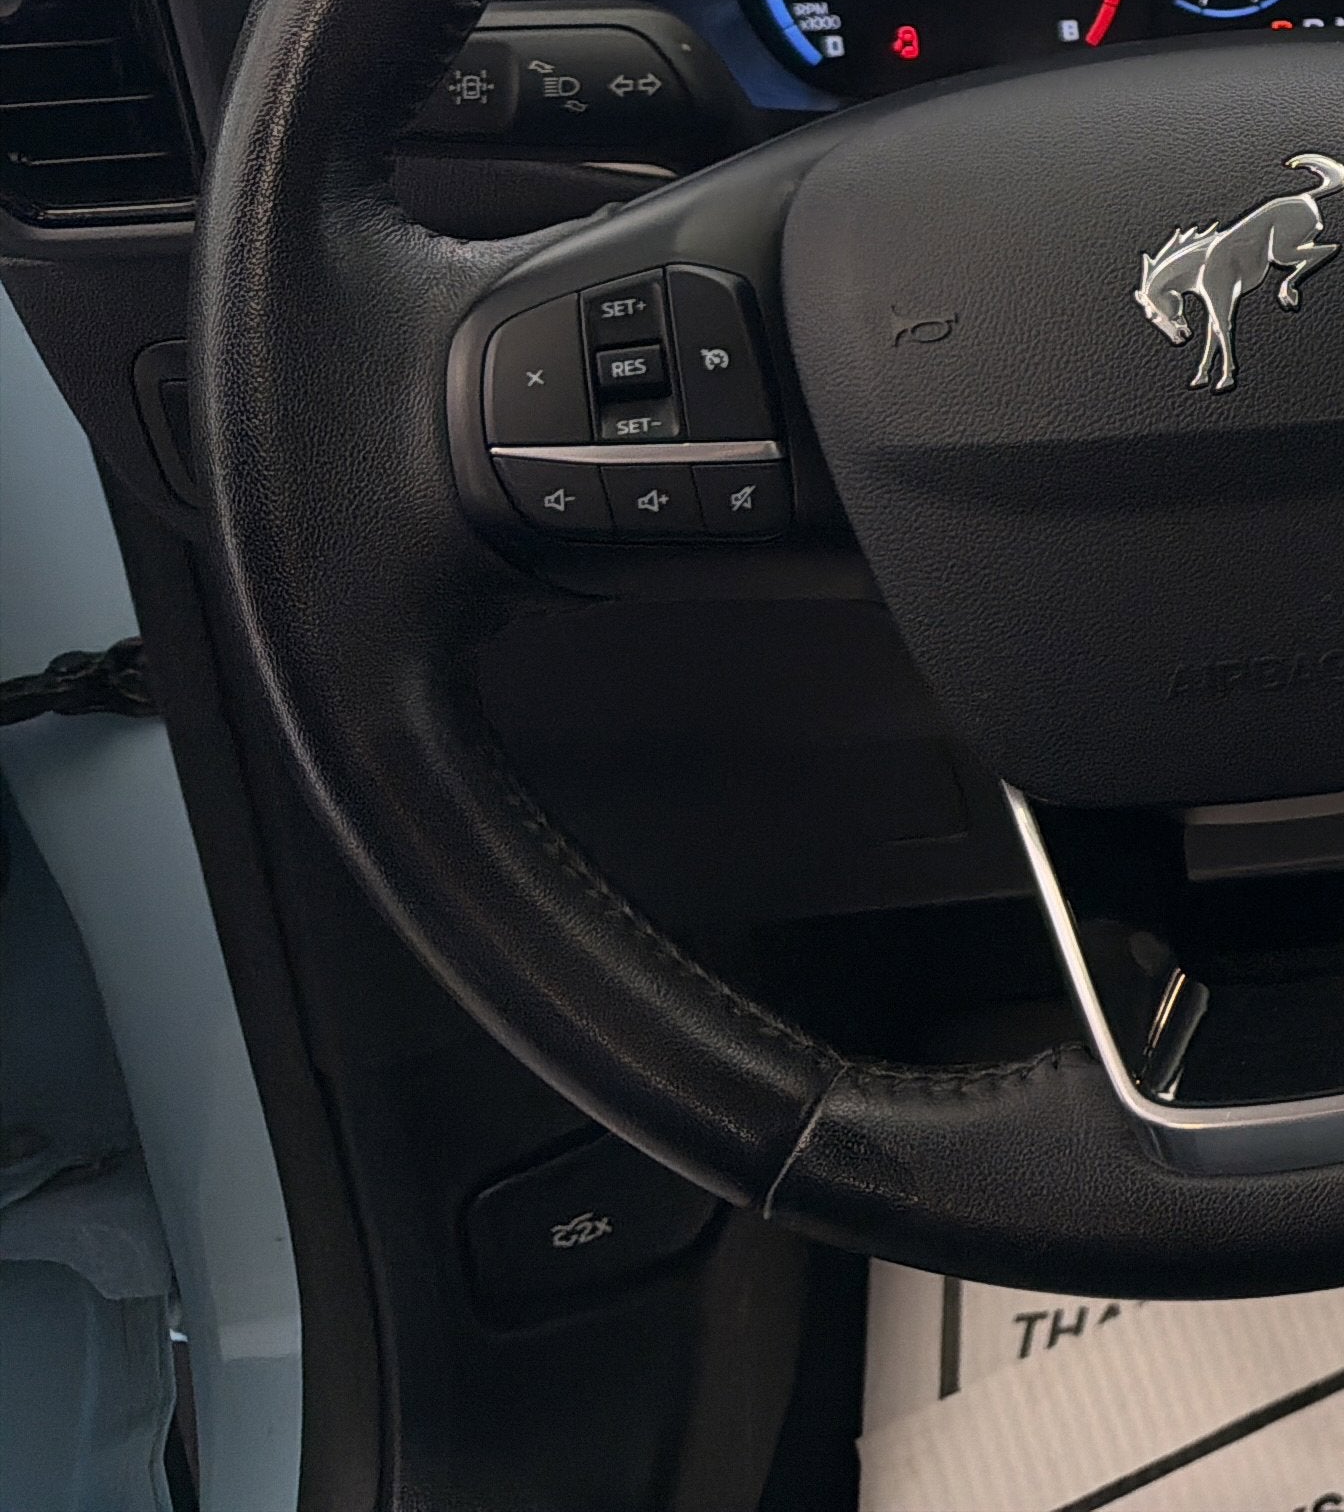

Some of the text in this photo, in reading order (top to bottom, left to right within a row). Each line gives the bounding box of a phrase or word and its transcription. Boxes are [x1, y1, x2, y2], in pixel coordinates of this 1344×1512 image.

[1058, 19, 1080, 42] 8
[823, 35, 845, 58] 0
[601, 299, 647, 319] SET+
[611, 359, 647, 378] RES
[616, 417, 662, 436] SET-
